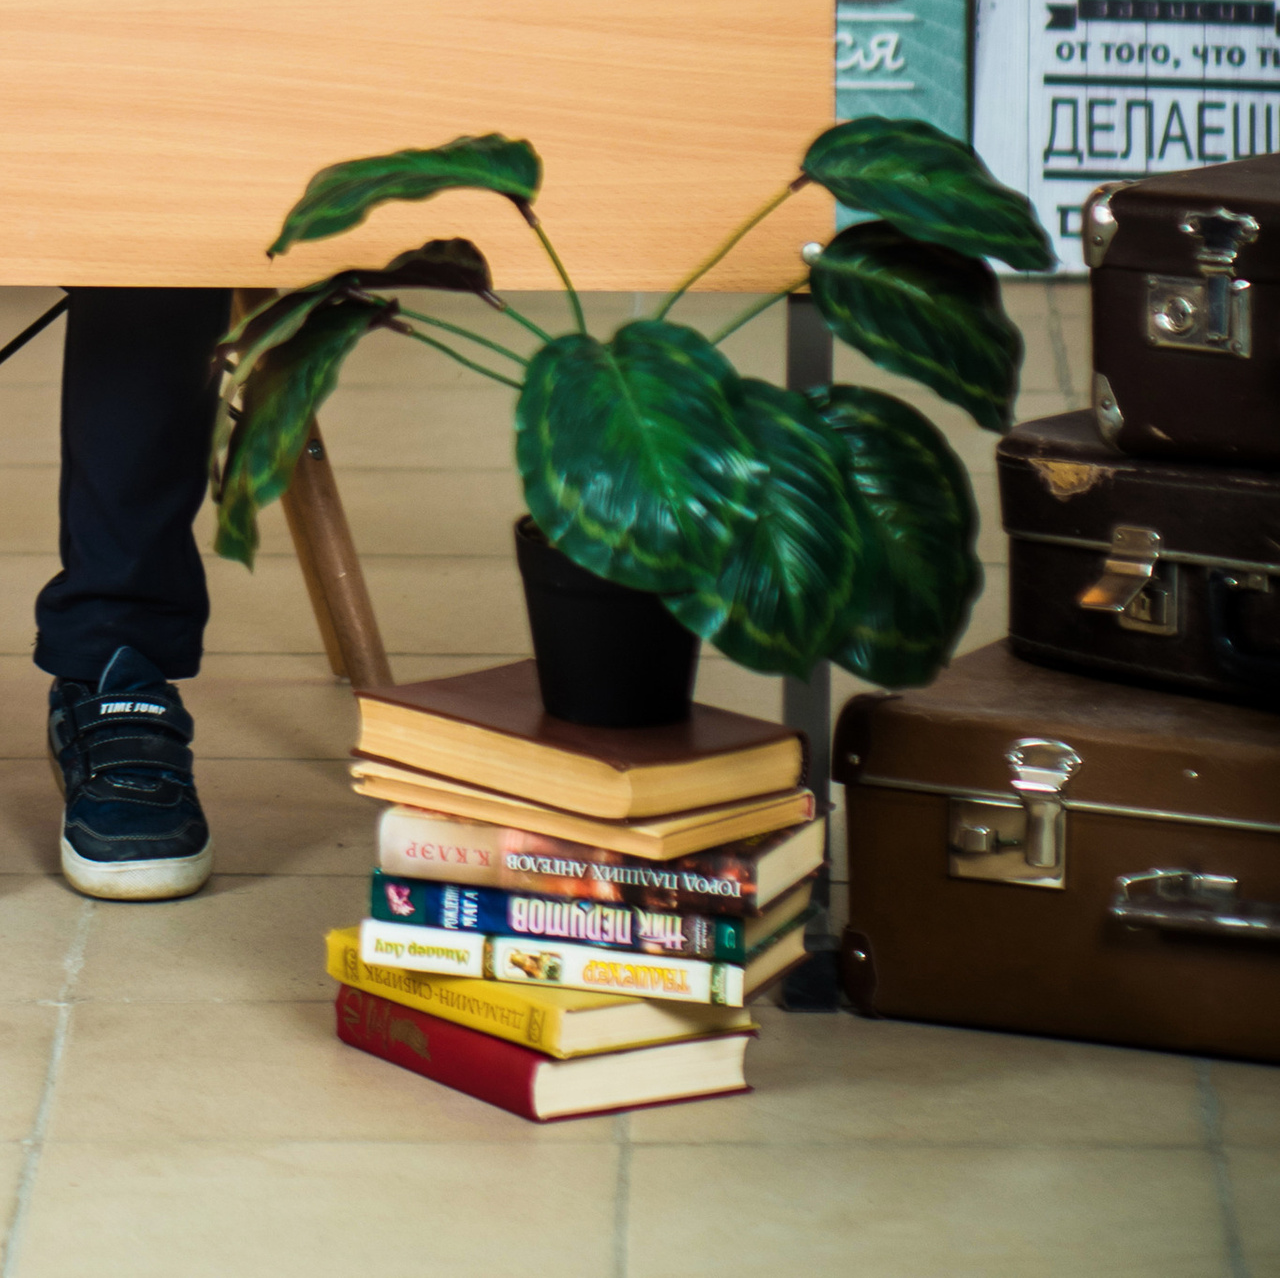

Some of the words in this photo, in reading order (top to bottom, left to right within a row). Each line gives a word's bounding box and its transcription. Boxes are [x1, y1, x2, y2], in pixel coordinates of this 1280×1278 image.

[1055, 41, 1091, 62] от
[1100, 42, 1181, 69] того,
[1192, 44, 1246, 67] что
[1043, 97, 1280, 165] ДЕЛАЕШ
[100, 701, 134, 715] TIME
[133, 702, 166, 715] JUMP
[405, 842, 468, 863] КЛЭР
[506, 853, 588, 878] АНГЕЛОВ
[592, 862, 679, 890] ПАДШИХ
[681, 873, 742, 897] ГОРОД
